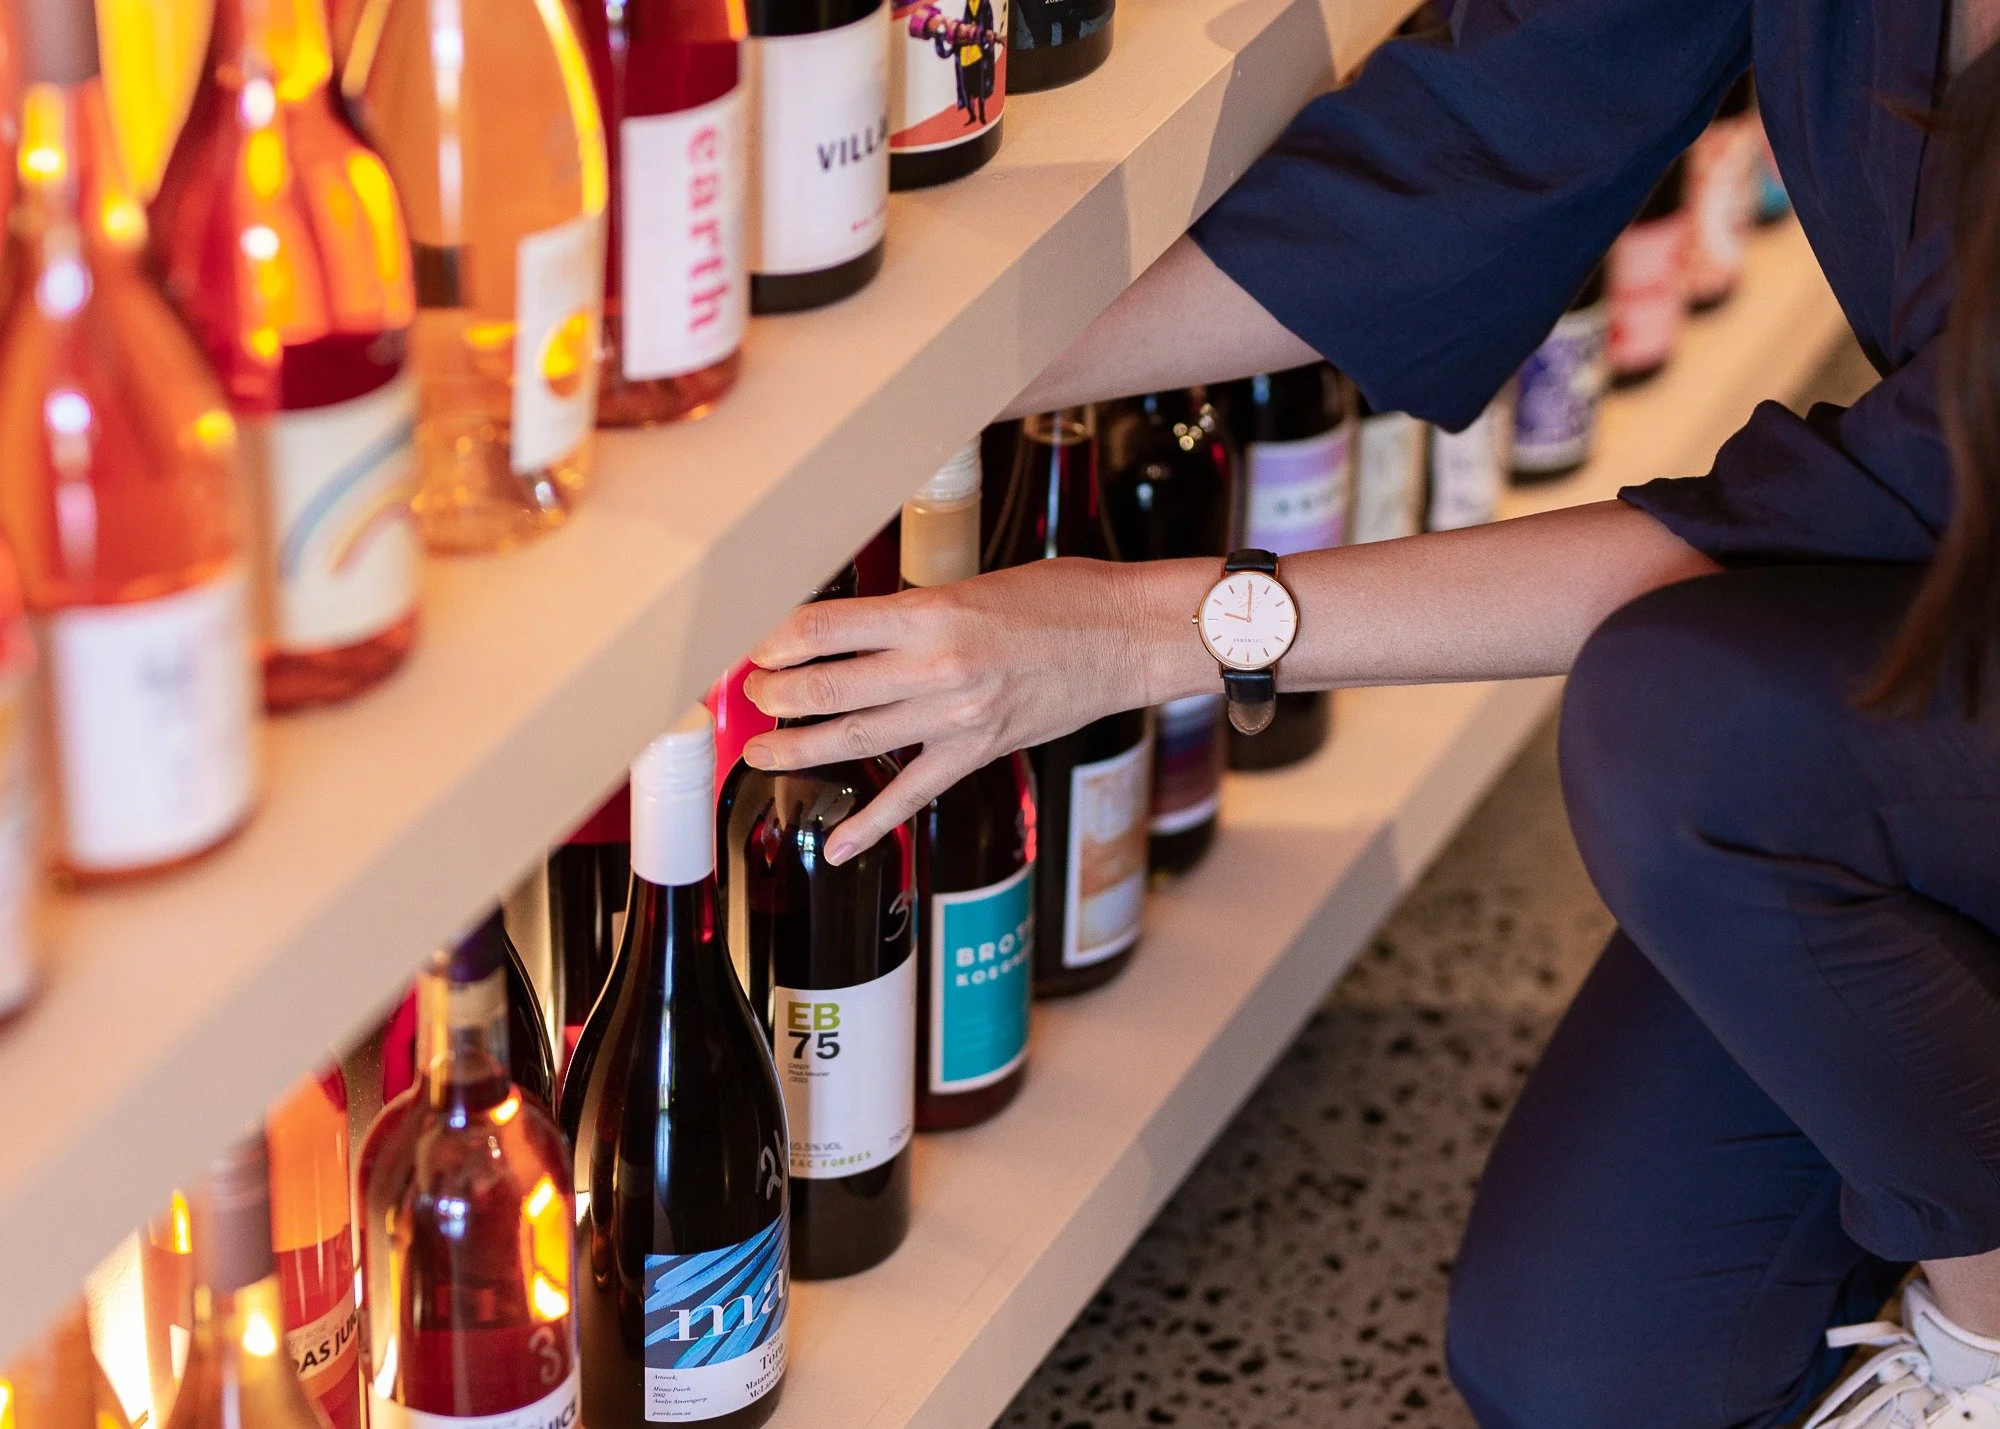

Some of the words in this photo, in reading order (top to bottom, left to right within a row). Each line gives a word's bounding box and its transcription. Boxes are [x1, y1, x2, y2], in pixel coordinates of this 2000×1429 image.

[687, 125, 730, 333] earth
[787, 1001, 841, 1031] EB
[788, 1031, 841, 1060] 75
